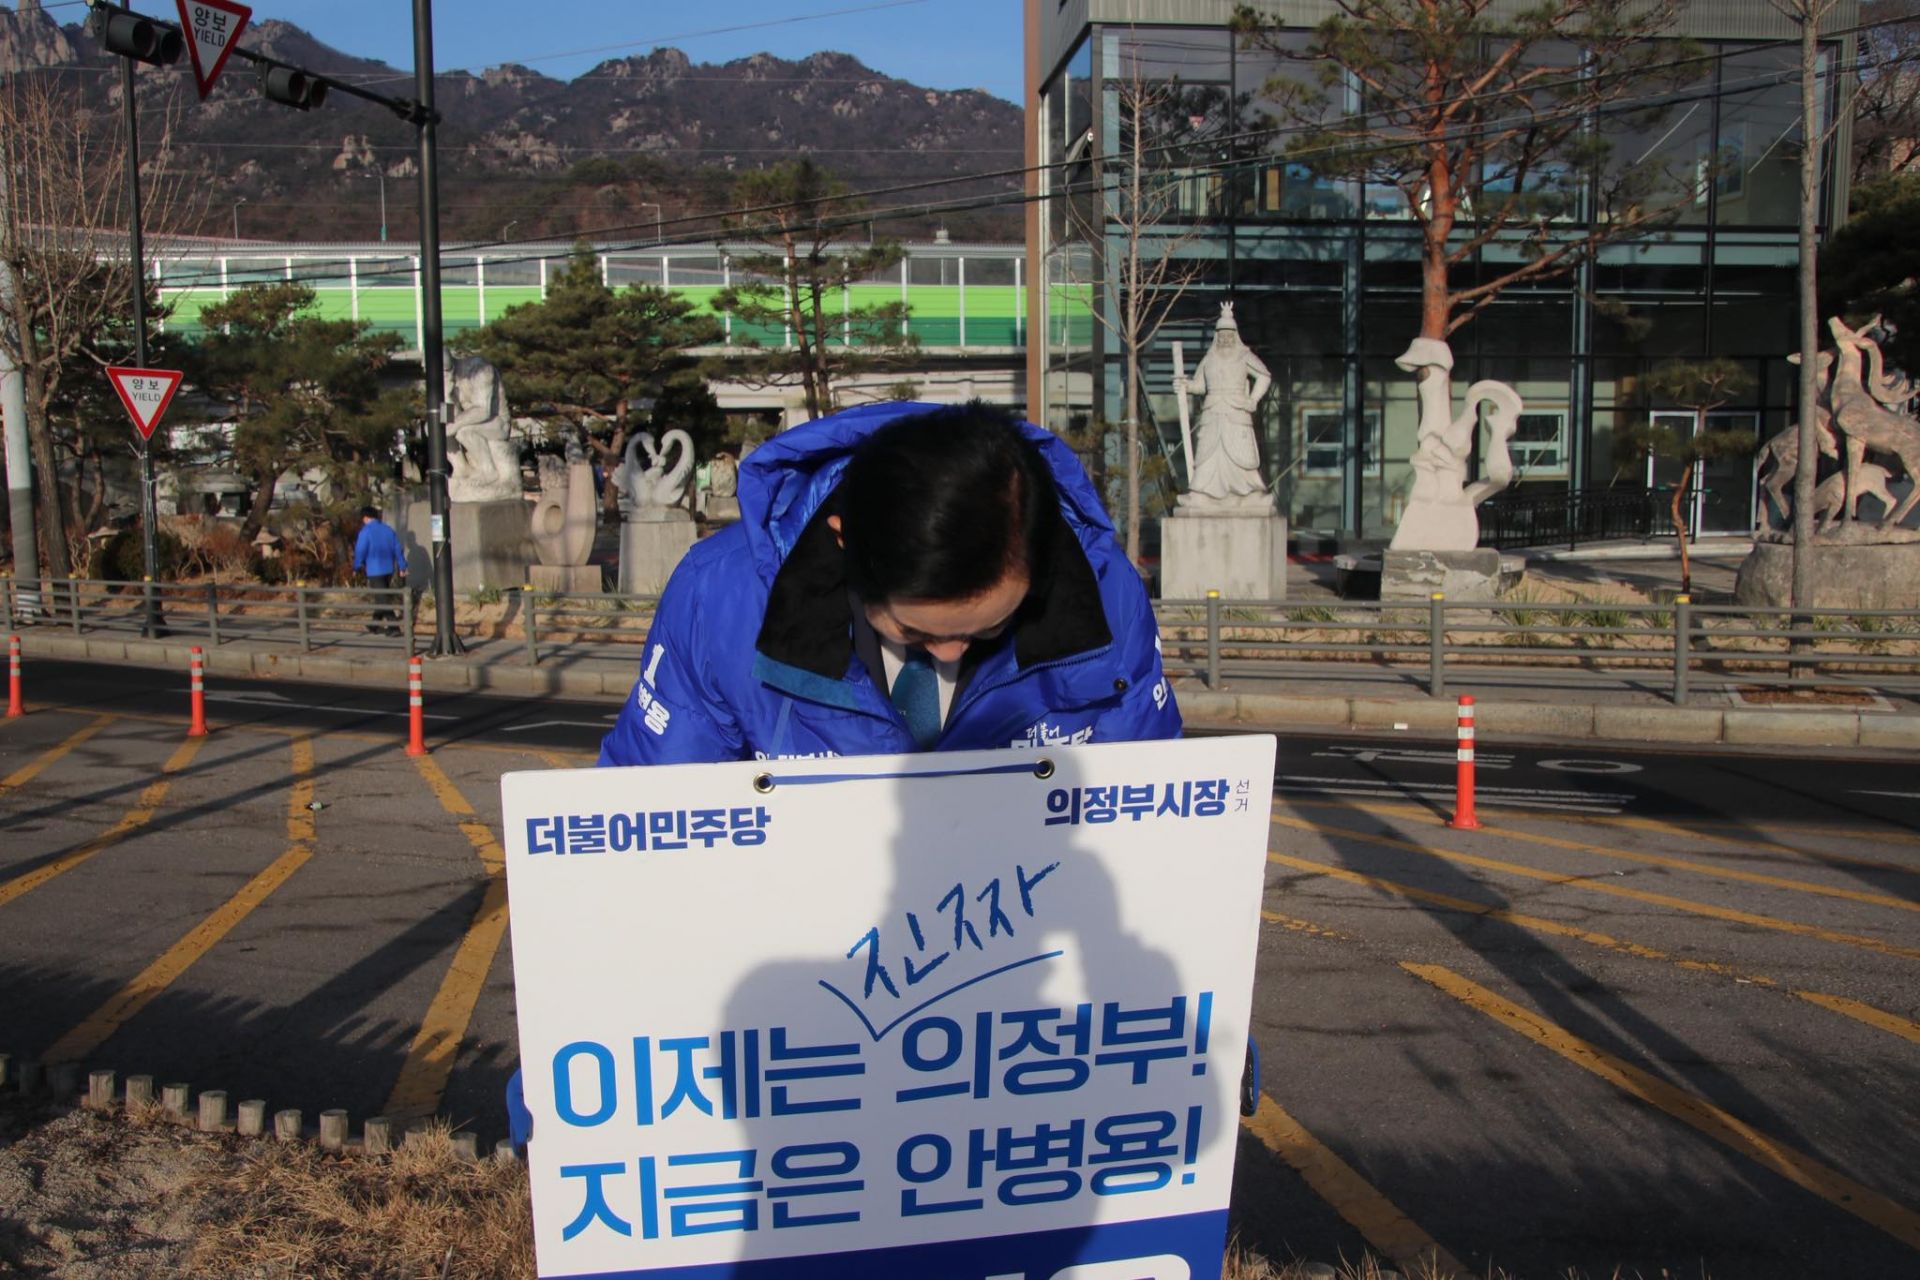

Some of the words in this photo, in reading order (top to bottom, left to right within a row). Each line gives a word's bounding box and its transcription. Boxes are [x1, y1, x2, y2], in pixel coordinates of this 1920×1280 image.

[194, 7, 227, 33] 양보
[194, 26, 226, 48] YIELD
[131, 391, 162, 402] YIELD
[132, 378, 160, 391] 양보
[1025, 722, 1061, 739] 더불어
[1045, 778, 1230, 826] 의정부시장
[1234, 778, 1250, 813] 선거
[526, 806, 772, 856] 더불어민주당
[847, 862, 1061, 999] 진짜
[552, 1026, 866, 1128] 이제는
[896, 991, 1214, 1103] 의정부!
[560, 1141, 865, 1243] 지금은
[896, 1105, 1203, 1218] 안병용!
